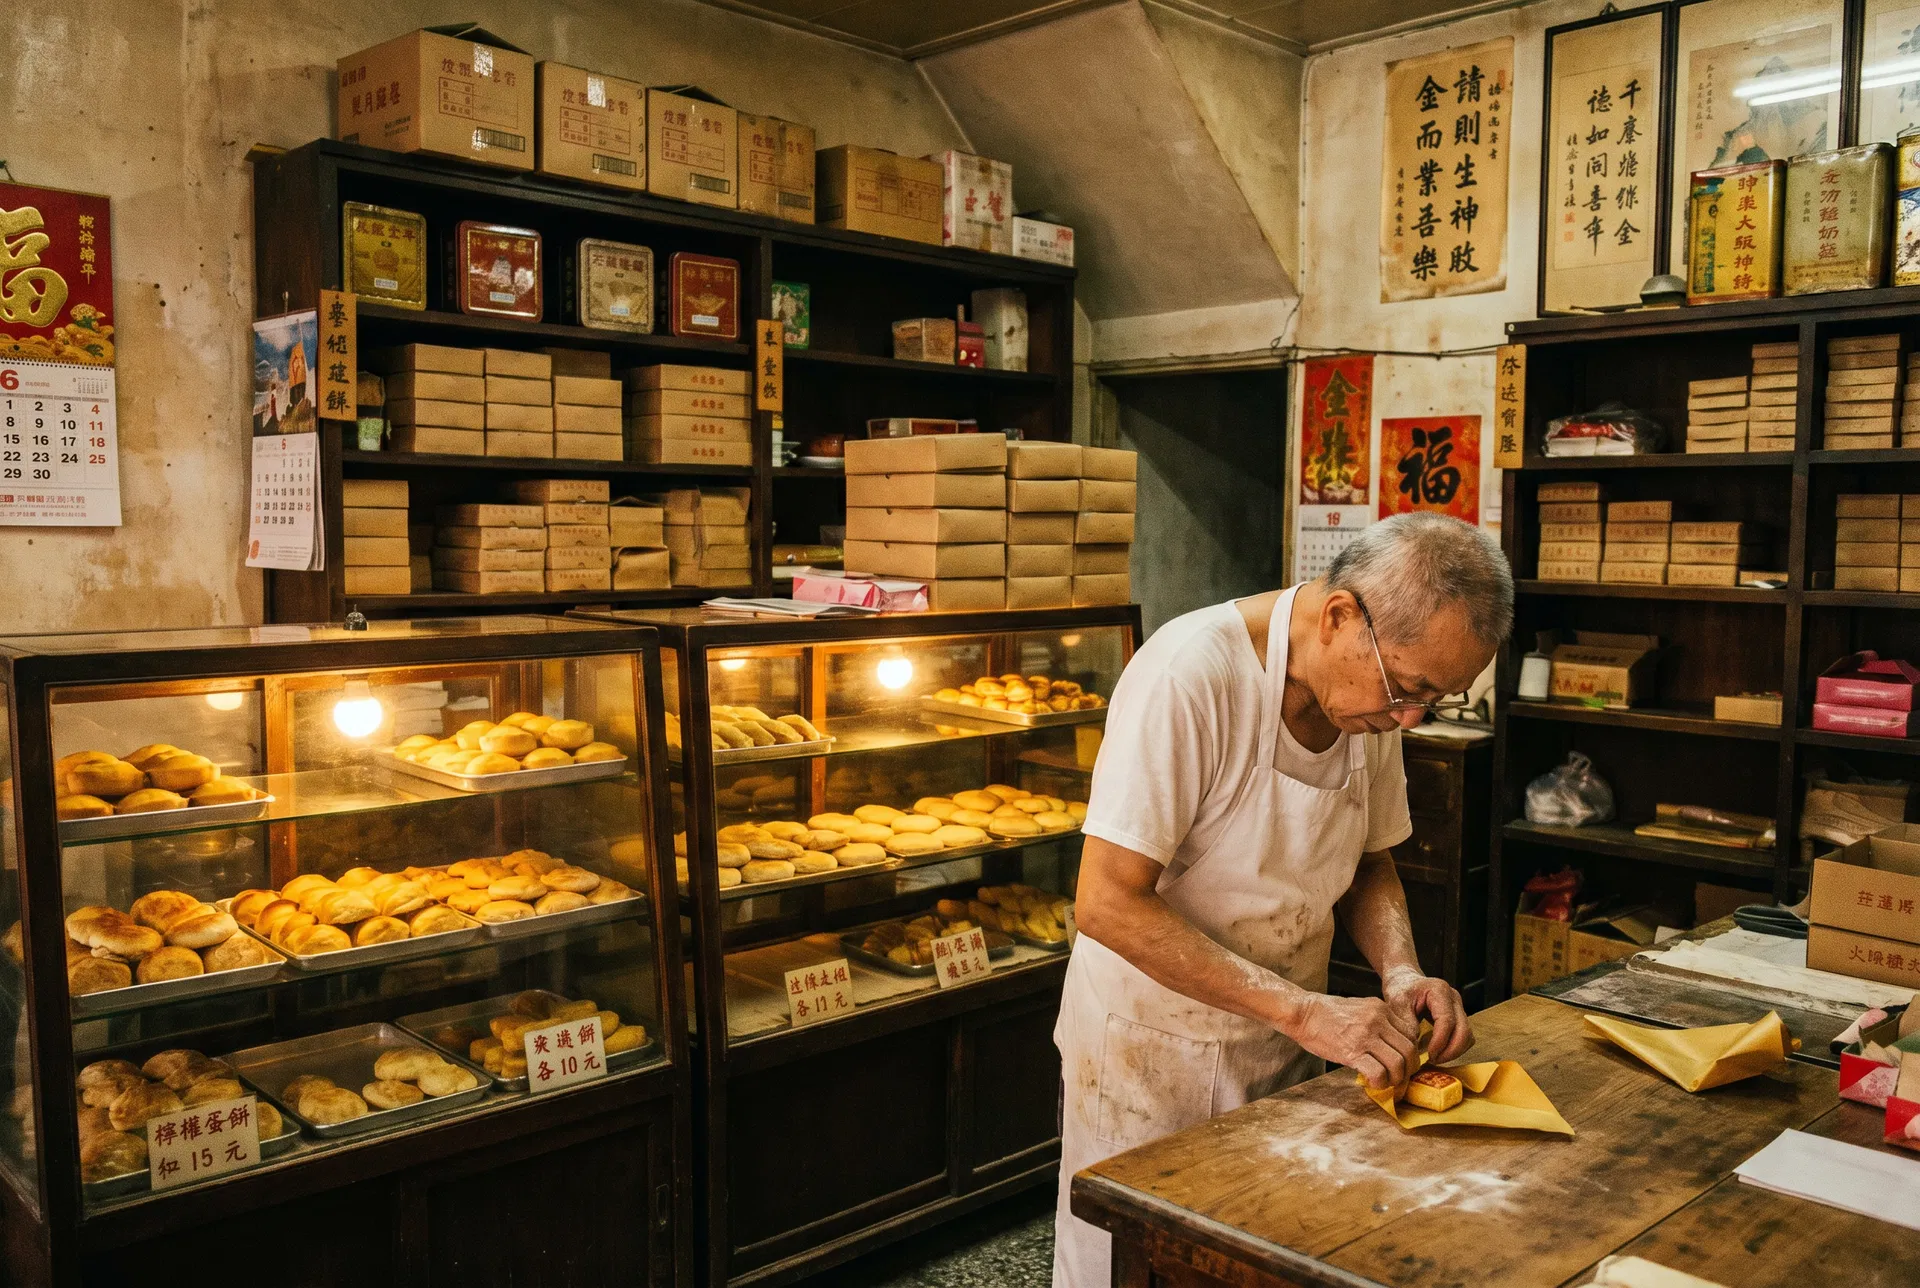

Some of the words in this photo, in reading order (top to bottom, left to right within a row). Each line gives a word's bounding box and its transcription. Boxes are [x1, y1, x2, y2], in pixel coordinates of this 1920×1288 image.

[0, 369, 20, 391] 6
[6, 400, 13, 410] 1
[34, 401, 43, 411] 2
[63, 403, 72, 413] 3
[91, 404, 100, 415] 4
[6, 416, 15, 427] 8
[35, 418, 44, 428] 9
[60, 419, 76, 430] 10
[89, 421, 103, 431] 11
[3, 434, 20, 444] 15
[32, 435, 49, 446] 16
[60, 436, 77, 447] 17
[89, 437, 105, 448] 18
[3, 451, 21, 461] 22
[32, 452, 50, 463] 23
[61, 453, 78, 463] 24
[89, 454, 106, 464] 25
[1397, 426, 1462, 505] 福
[4, 468, 22, 479] 29
[33, 469, 51, 479] 30
